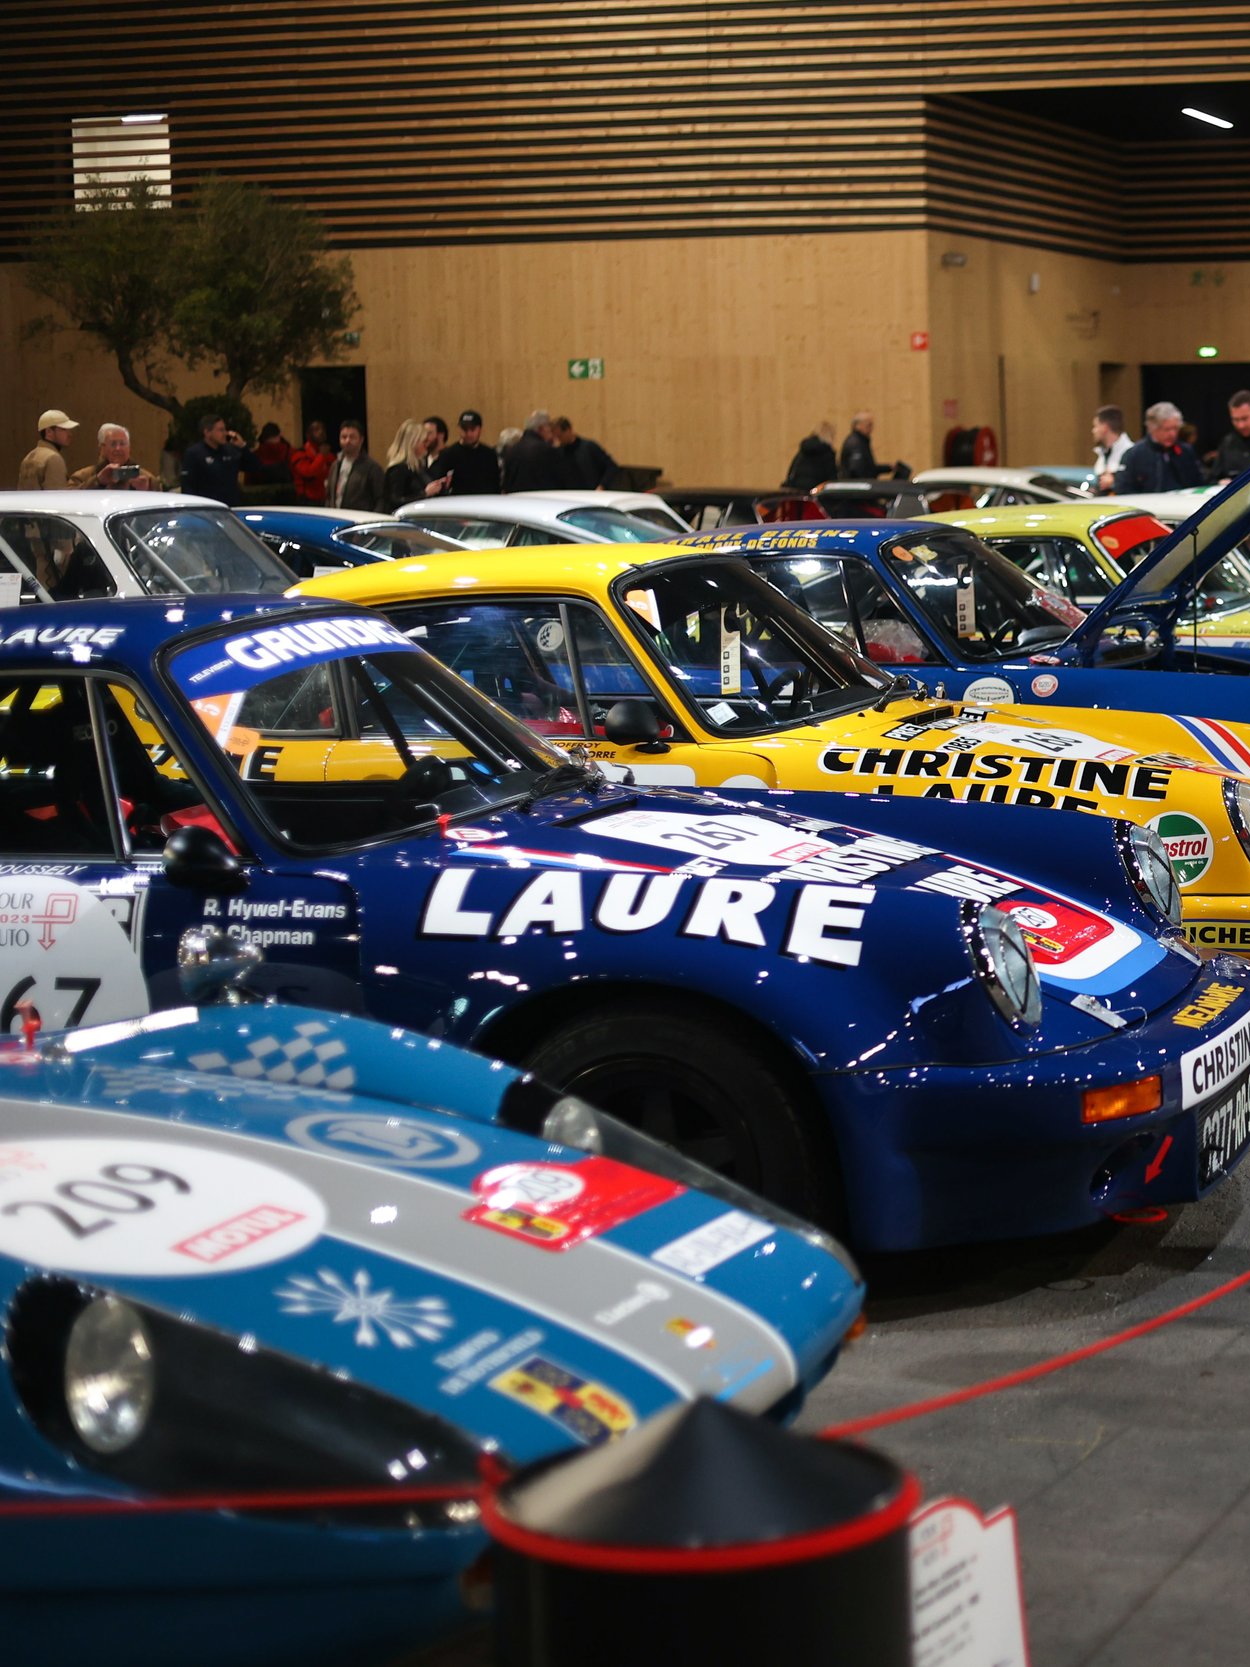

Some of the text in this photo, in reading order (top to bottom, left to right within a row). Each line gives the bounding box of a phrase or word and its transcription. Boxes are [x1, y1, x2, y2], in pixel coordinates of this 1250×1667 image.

[661, 532, 746, 545] ARAGE
[942, 736, 982, 751] OBES
[822, 748, 1173, 800] CHRISTINE
[660, 820, 759, 850] 267
[1163, 838, 1207, 857] astrol
[0, 865, 88, 876] OUSSELY
[0, 893, 33, 910] OUR
[203, 898, 346, 921] R. Hywel-Evans
[0, 915, 29, 923] 023
[421, 867, 877, 966] LAURE
[0, 929, 29, 947] UTO
[227, 926, 313, 948] Chapman
[0, 975, 102, 1036] 67
[1, 1162, 192, 1240] 209
[184, 1207, 296, 1259] MOTUL
